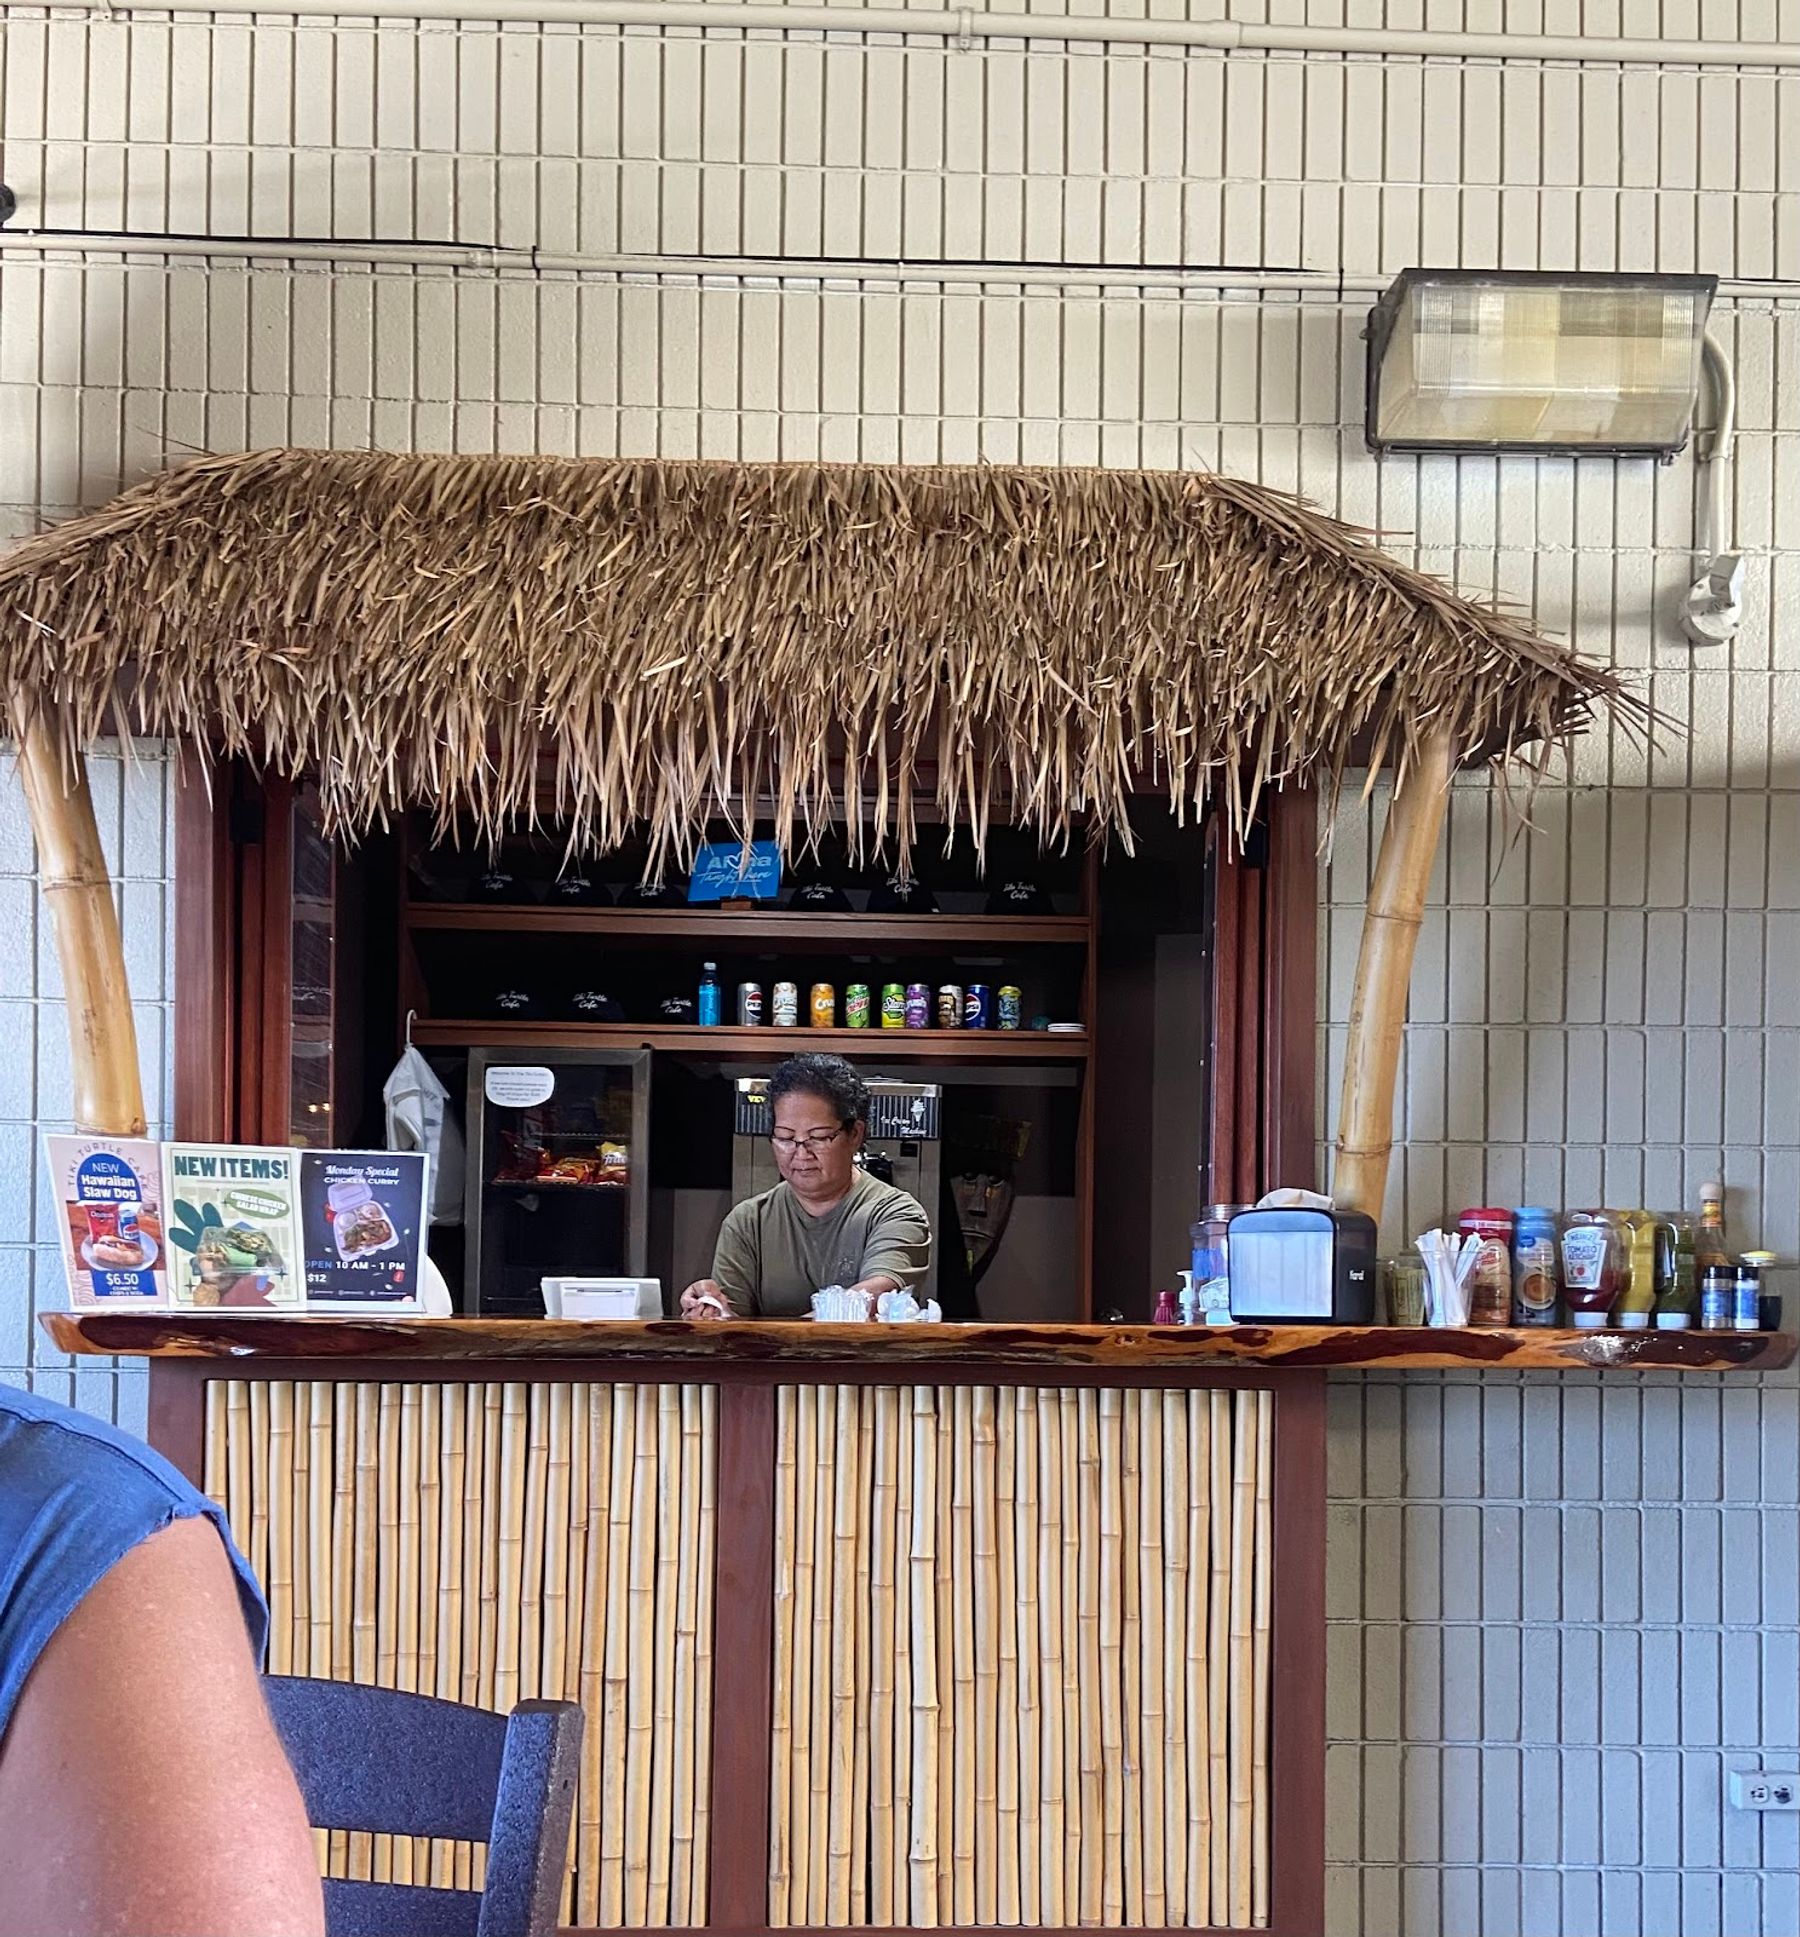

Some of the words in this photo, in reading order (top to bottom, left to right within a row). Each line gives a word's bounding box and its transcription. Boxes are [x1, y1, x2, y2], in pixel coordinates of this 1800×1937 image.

[78, 1142, 122, 1156] TURTLE
[92, 1163, 119, 1173] NEW
[174, 1156, 217, 1177] NEW
[220, 1157, 289, 1179] ITEMS!
[325, 1165, 364, 1176] Monday
[365, 1166, 399, 1177] Special
[83, 1187, 111, 1198] Slaw
[113, 1188, 137, 1201] Dog
[336, 1261, 348, 1269] 10
[388, 1262, 405, 1270] PM
[106, 1273, 139, 1286] $6.50
[307, 1273, 327, 1283] $12
